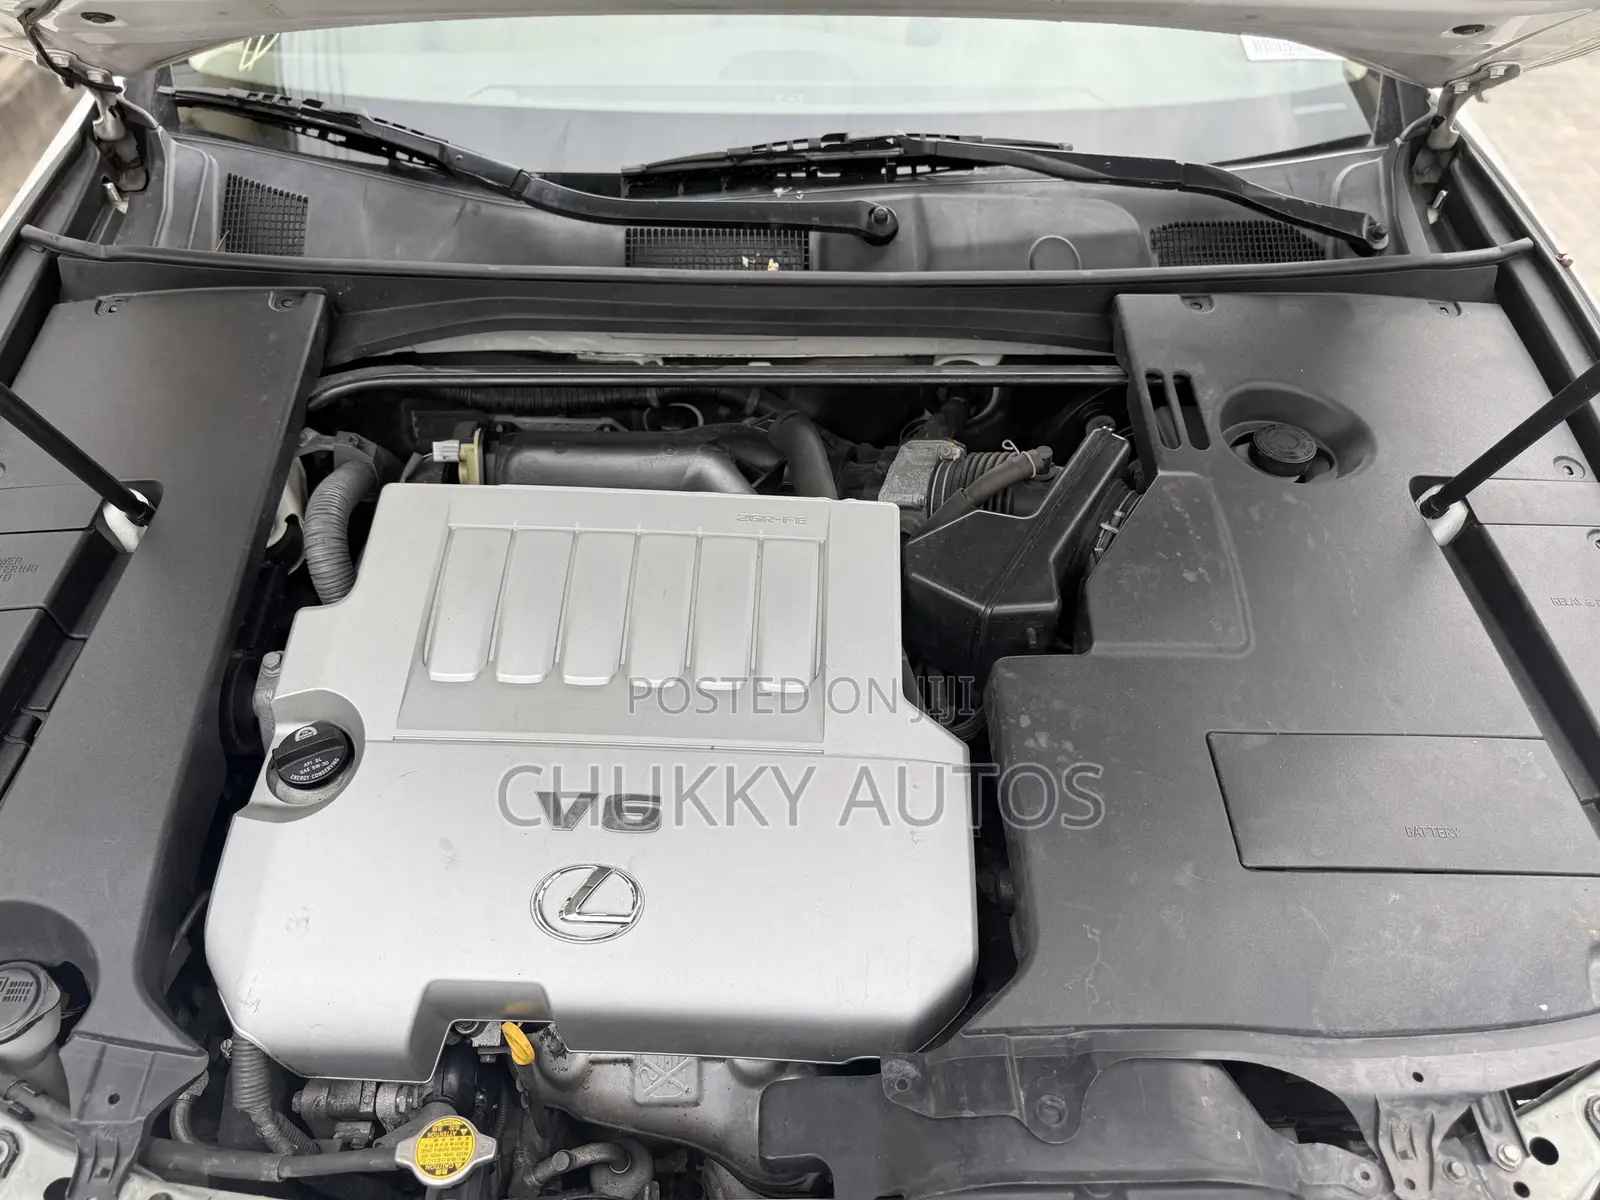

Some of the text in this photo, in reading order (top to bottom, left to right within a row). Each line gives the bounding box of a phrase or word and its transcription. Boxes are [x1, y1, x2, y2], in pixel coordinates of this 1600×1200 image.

[736, 513, 808, 525] 2GR-FE
[1550, 596, 1582, 606] RELAY
[311, 757, 340, 779] CONSERVING
[534, 791, 663, 834] V6
[1404, 825, 1460, 839] BATTERY
